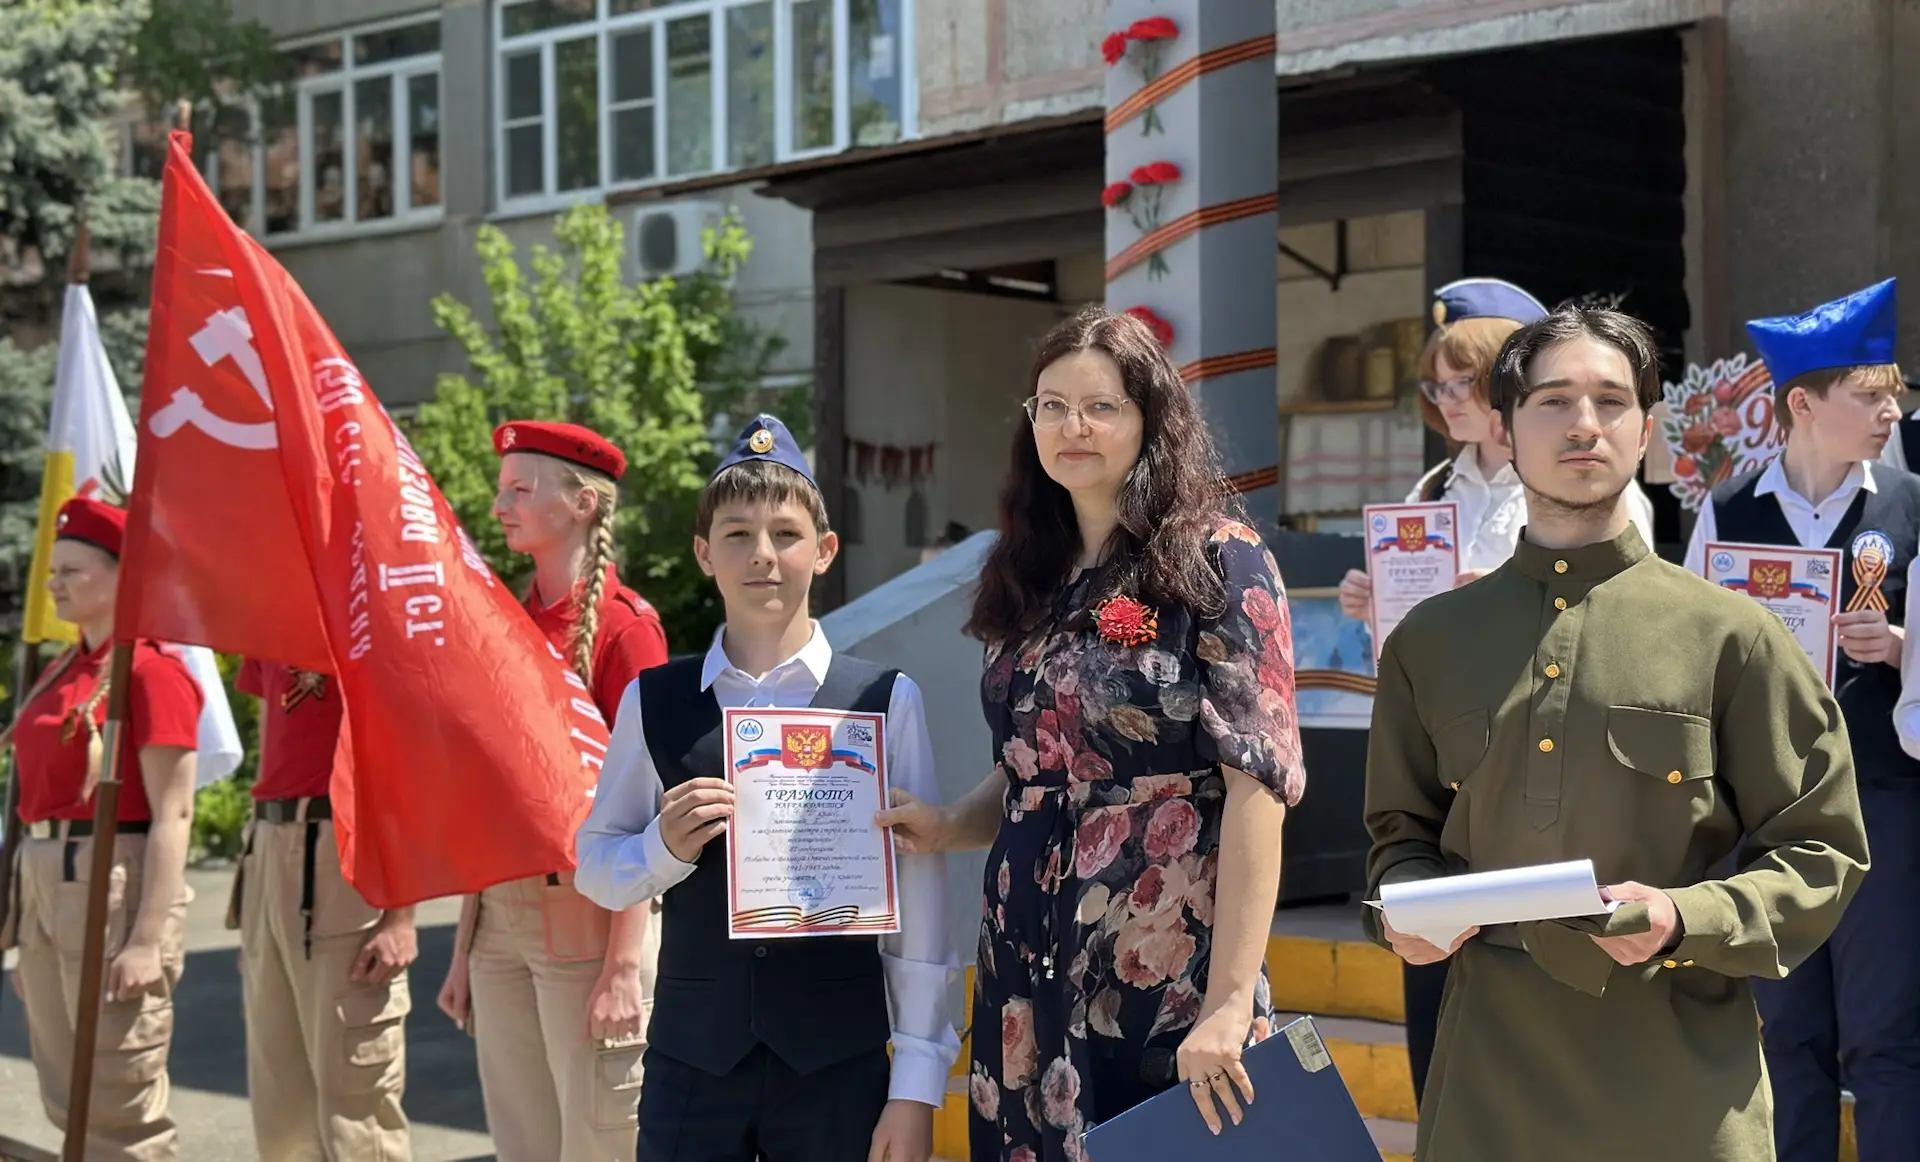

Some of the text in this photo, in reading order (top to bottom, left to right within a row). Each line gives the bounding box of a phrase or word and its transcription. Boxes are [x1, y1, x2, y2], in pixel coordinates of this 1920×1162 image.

[1744, 396, 1774, 450] 9
[765, 789, 853, 802] ГРАМОТА
[775, 802, 845, 810] НАГРАЖДАЕТСЯ
